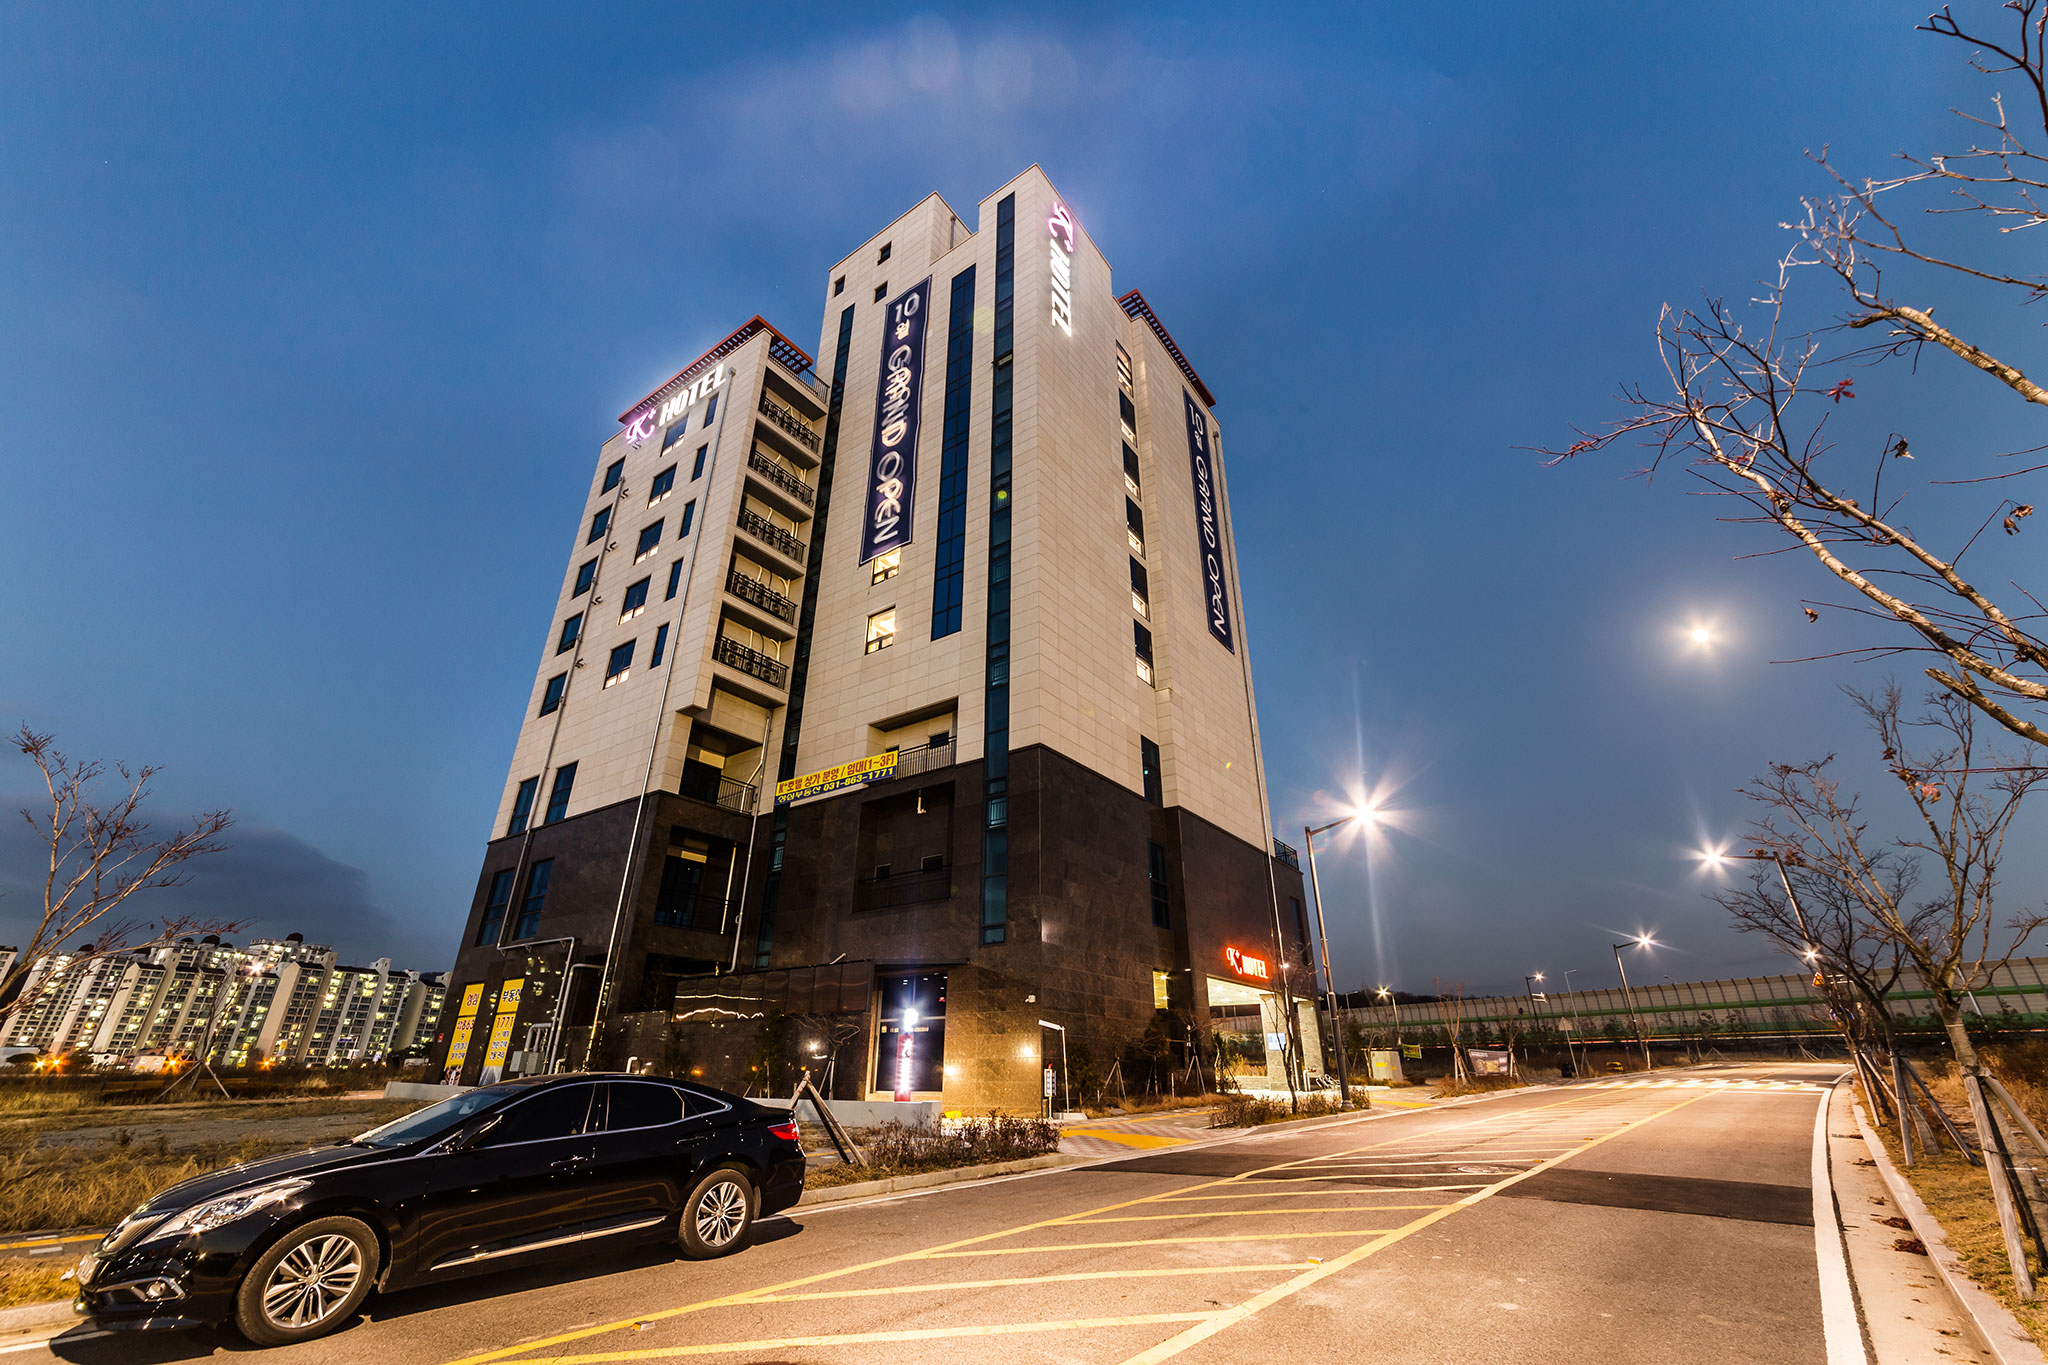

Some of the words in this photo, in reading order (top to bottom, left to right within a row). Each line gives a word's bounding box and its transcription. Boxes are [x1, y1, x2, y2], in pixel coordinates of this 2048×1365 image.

[1050, 238, 1073, 337] HOTEL
[658, 364, 727, 427] HOTEL
[881, 344, 912, 447] GRAND
[873, 451, 905, 544] OPEN
[1196, 456, 1216, 549] GRAND
[1208, 554, 1227, 636] OPEN
[804, 774, 821, 788] 상가
[1242, 955, 1269, 979] HOTEL
[496, 1016, 514, 1029] 1771
